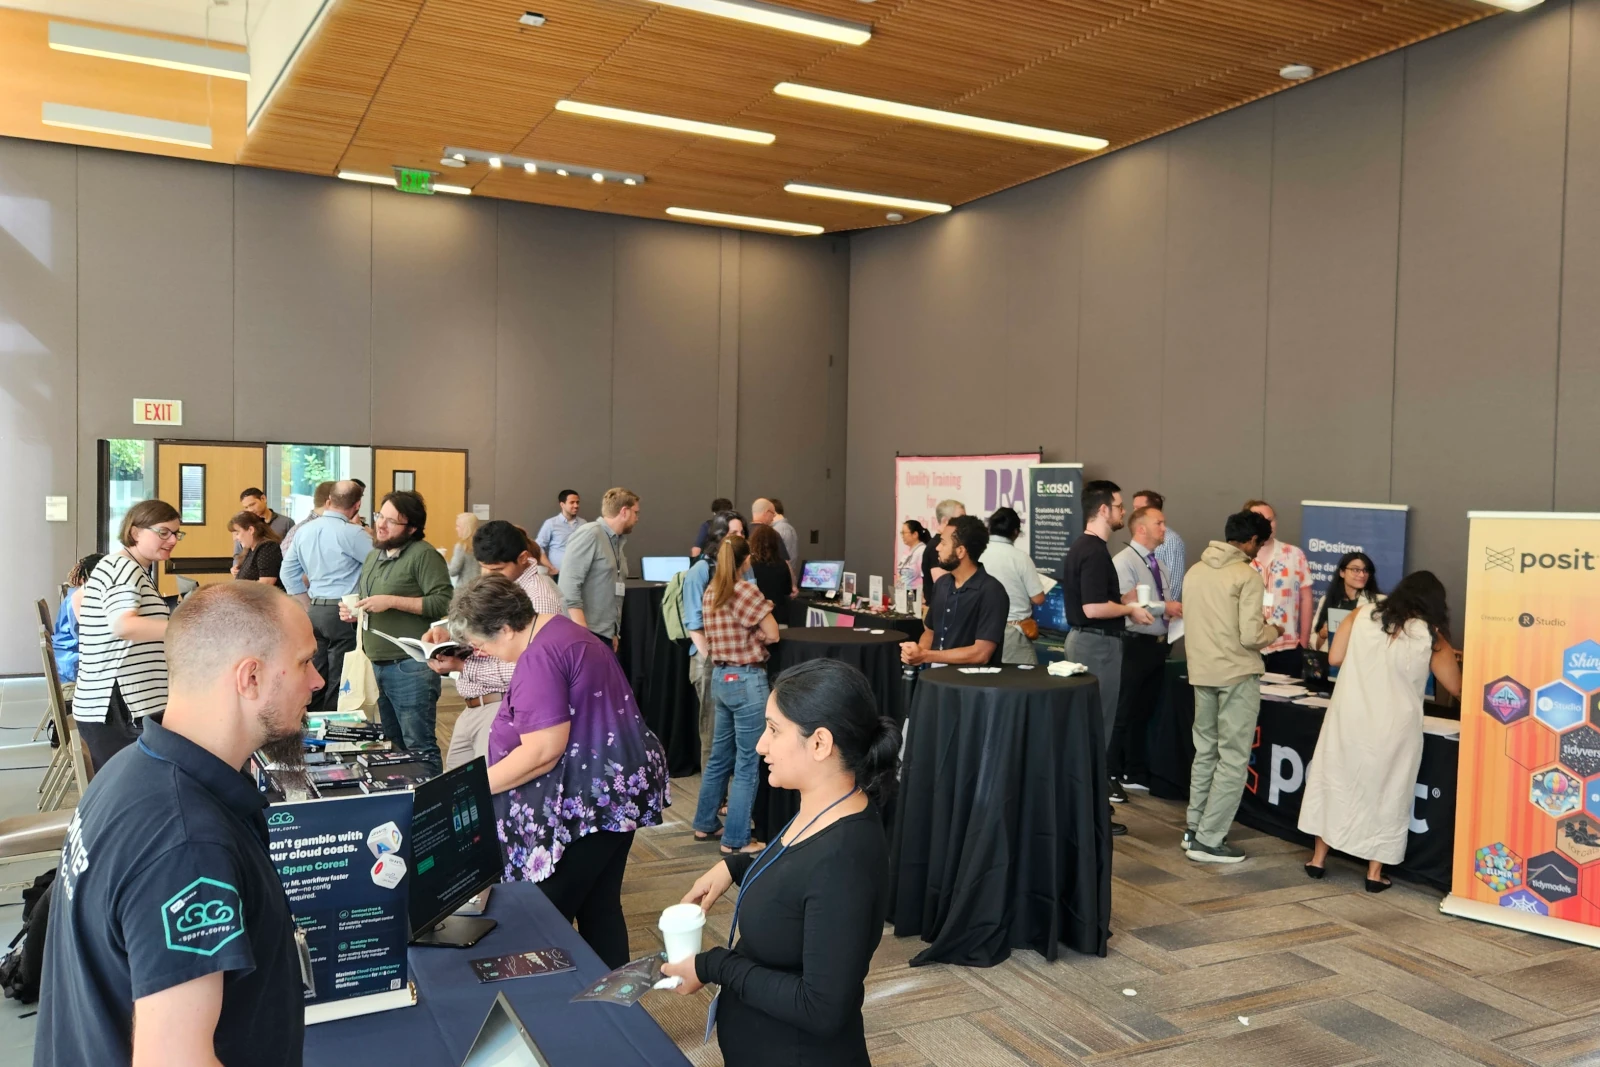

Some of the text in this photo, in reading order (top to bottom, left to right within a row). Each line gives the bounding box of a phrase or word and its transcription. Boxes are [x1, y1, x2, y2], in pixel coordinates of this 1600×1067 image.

[144, 403, 172, 421] EXIT
[906, 471, 962, 490] Quality Training
[1036, 480, 1074, 493] Exasol
[984, 468, 1026, 512] DRA
[1319, 540, 1363, 554] Positron
[1309, 561, 1337, 572] The dat
[1520, 548, 1596, 574] posit
[1311, 573, 1326, 582] ode
[1480, 613, 1506, 622] Creators
[1563, 744, 1600, 758] tidyvers
[269, 831, 363, 850] on't gamble with
[289, 848, 322, 860] cloud
[323, 844, 358, 856] costs.
[282, 863, 313, 875] Spare
[315, 858, 349, 870] Cores!
[1486, 867, 1512, 878] ELLMER
[290, 879, 301, 887] ML
[301, 876, 330, 885] workflow
[330, 873, 349, 881] faster
[312, 883, 332, 891] config
[1532, 880, 1572, 894] tidymodels
[289, 894, 317, 902] required.
